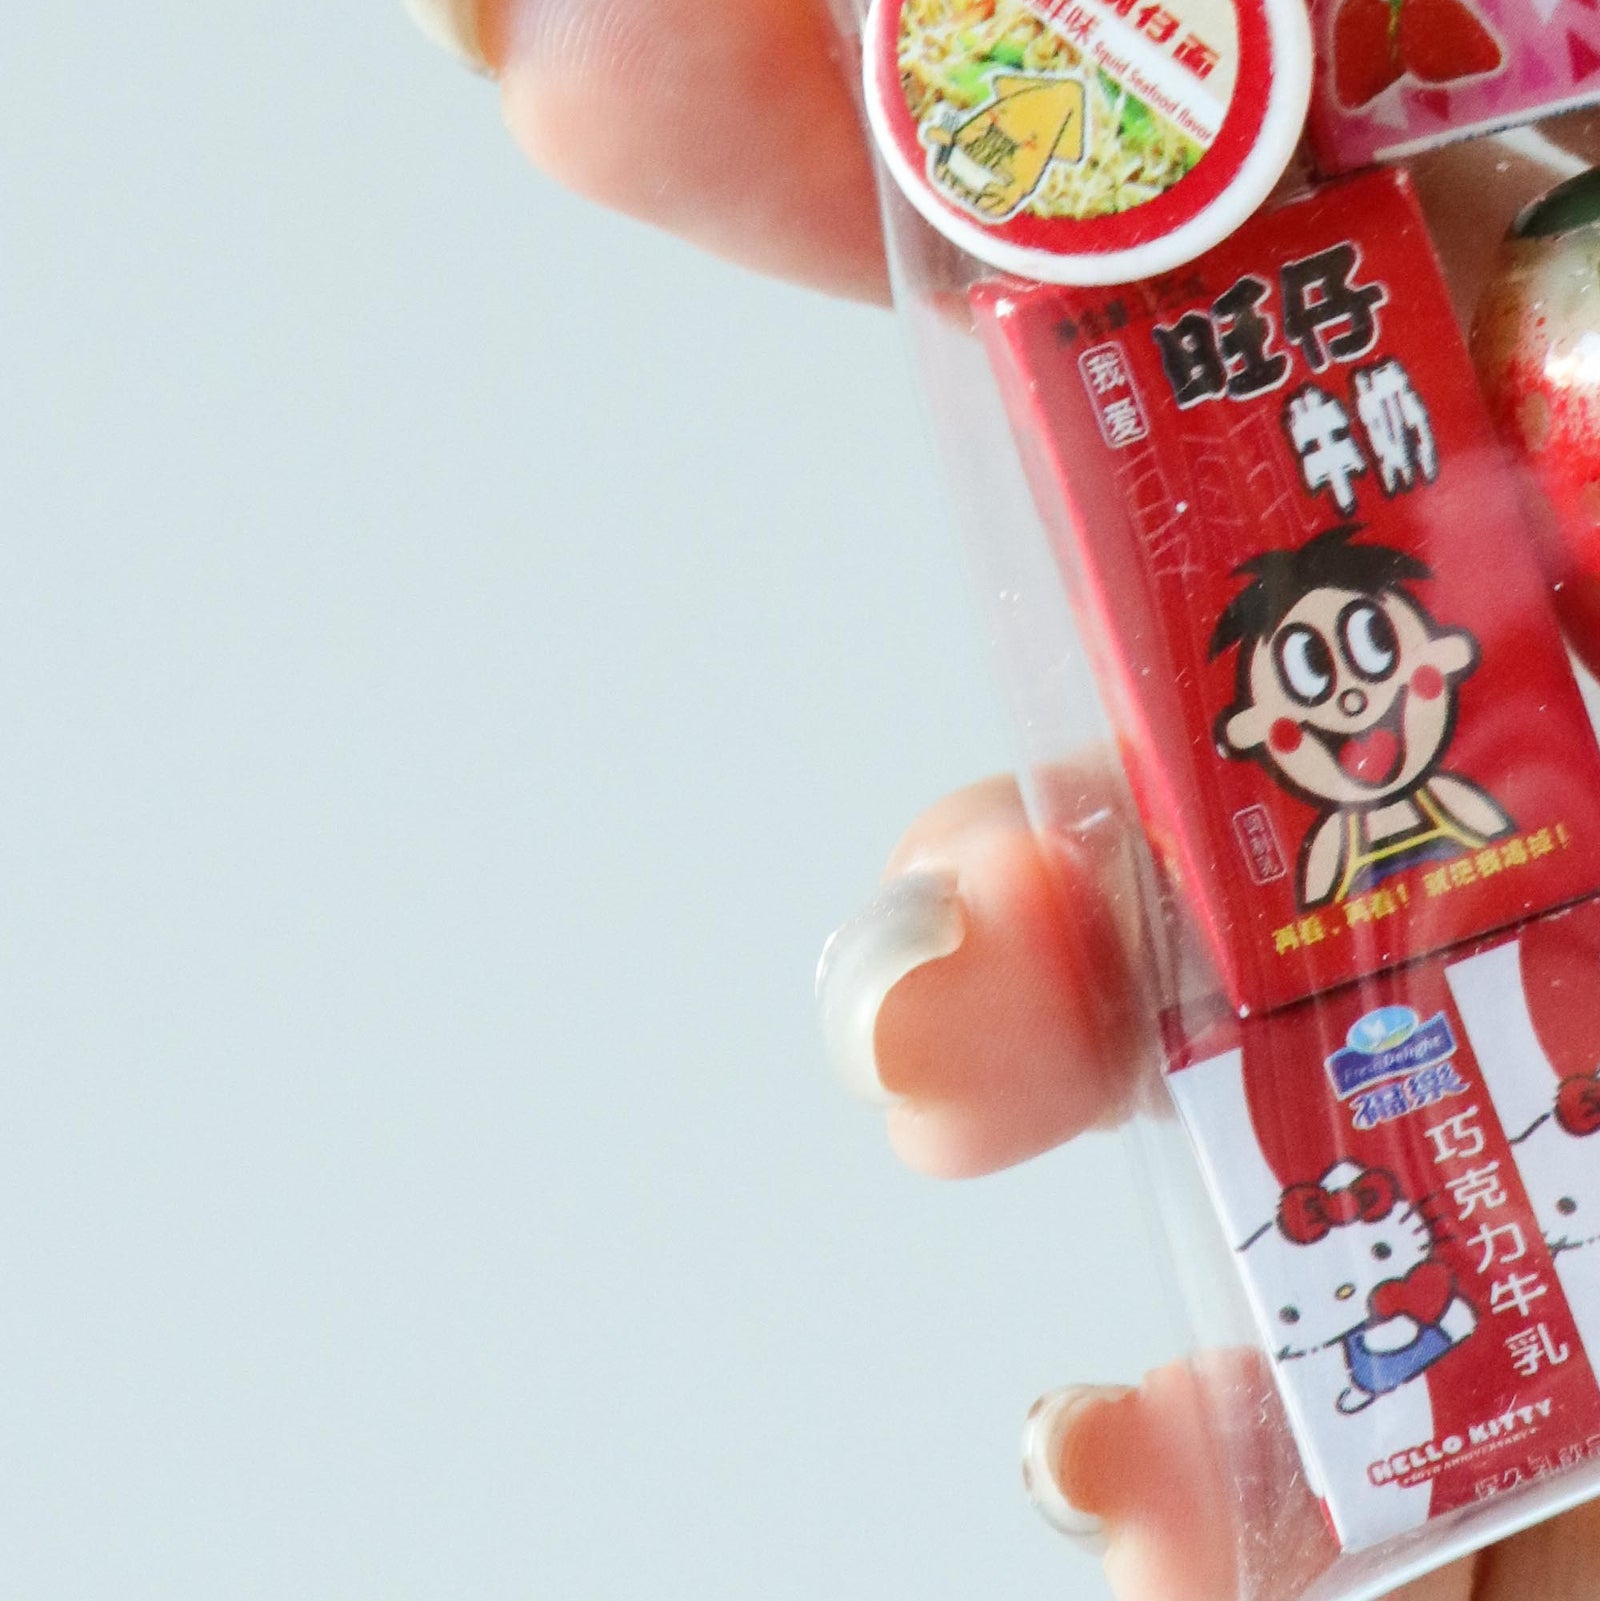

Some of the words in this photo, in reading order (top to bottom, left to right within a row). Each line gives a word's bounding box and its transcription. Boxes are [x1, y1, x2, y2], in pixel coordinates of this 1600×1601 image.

[1152, 241, 1388, 410] 旺仔
[1284, 358, 1440, 517] 牛奶
[1424, 1104, 1571, 1377] 巧克力牛乳
[1369, 1432, 1465, 1484] HELLO
[1466, 1396, 1556, 1445] KITTY
